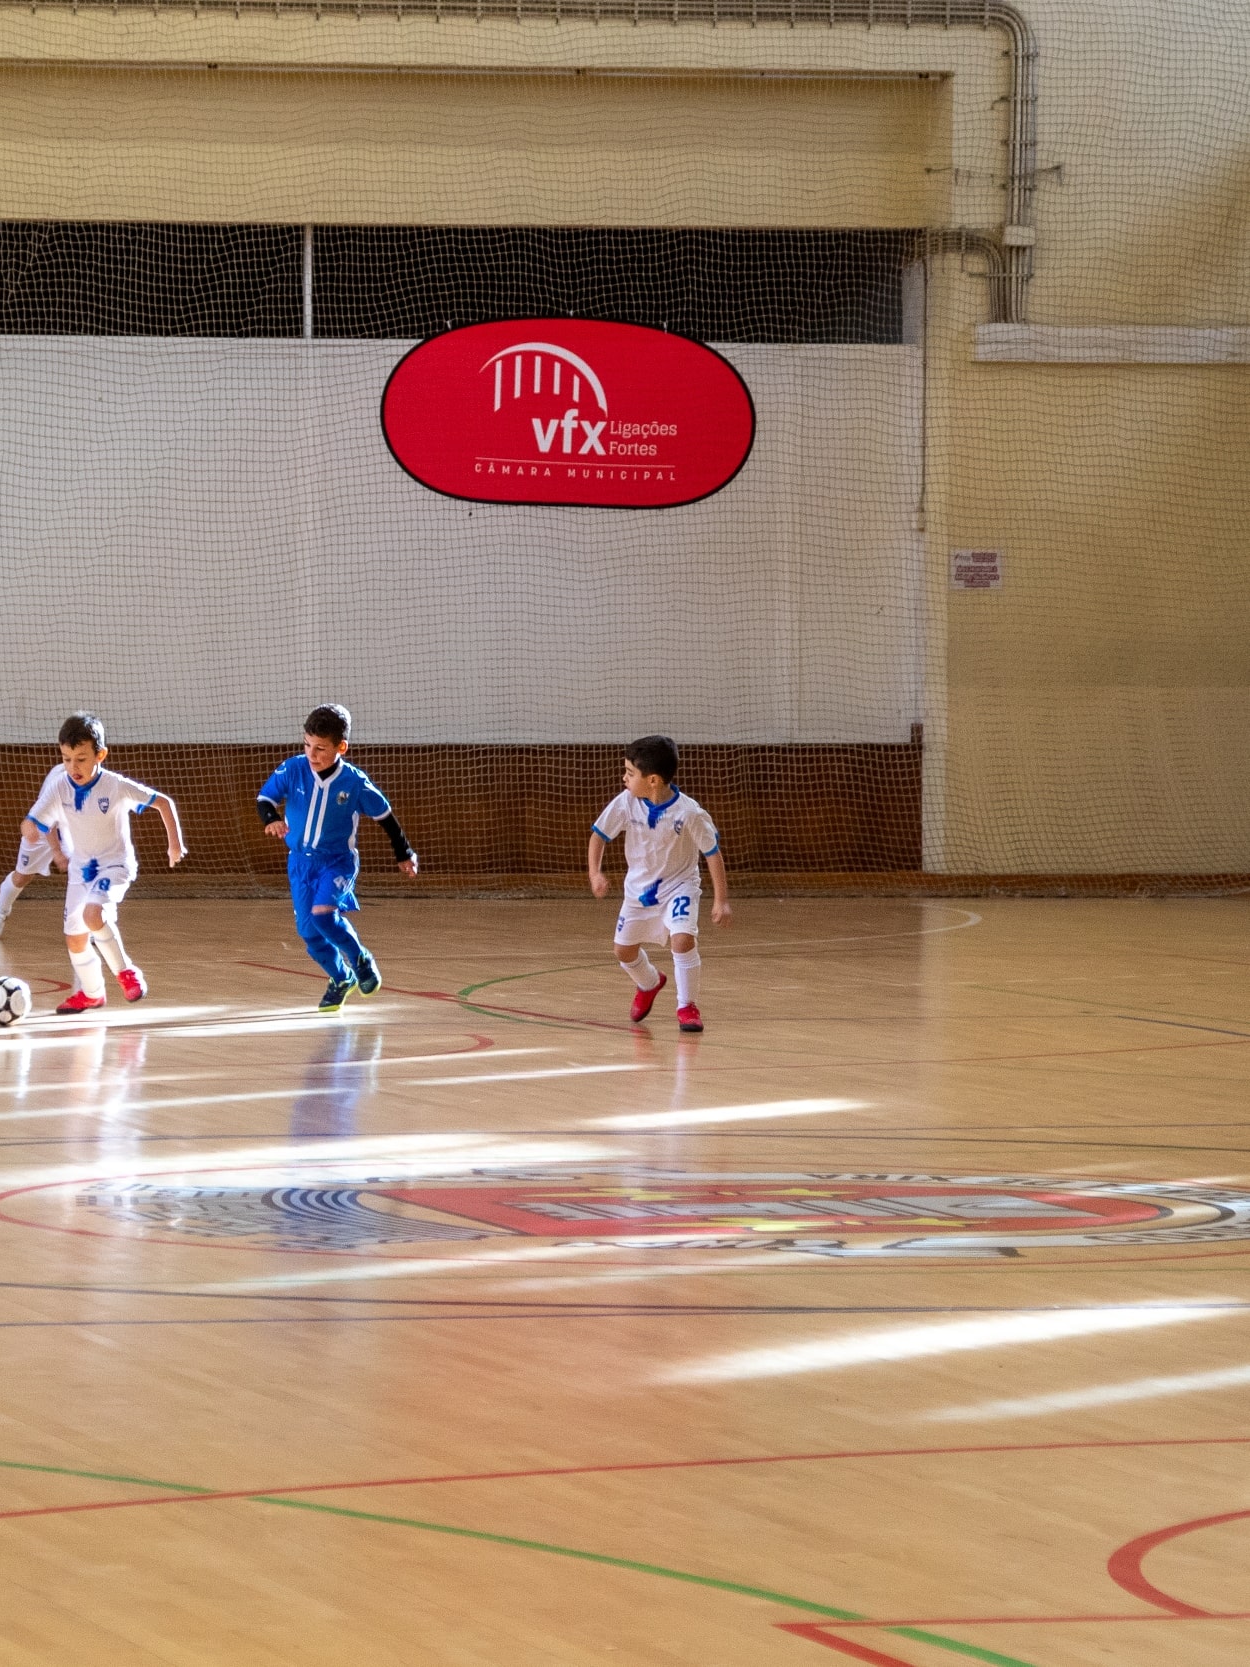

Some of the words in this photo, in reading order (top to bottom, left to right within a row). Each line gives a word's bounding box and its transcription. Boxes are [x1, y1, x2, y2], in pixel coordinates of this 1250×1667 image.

[531, 408, 608, 456] vfx
[609, 420, 678, 439] Ligações
[609, 441, 658, 456] Fortes
[474, 462, 552, 477] CÂMARA
[567, 468, 676, 481] MUNICIPAL
[672, 895, 691, 918] 22
